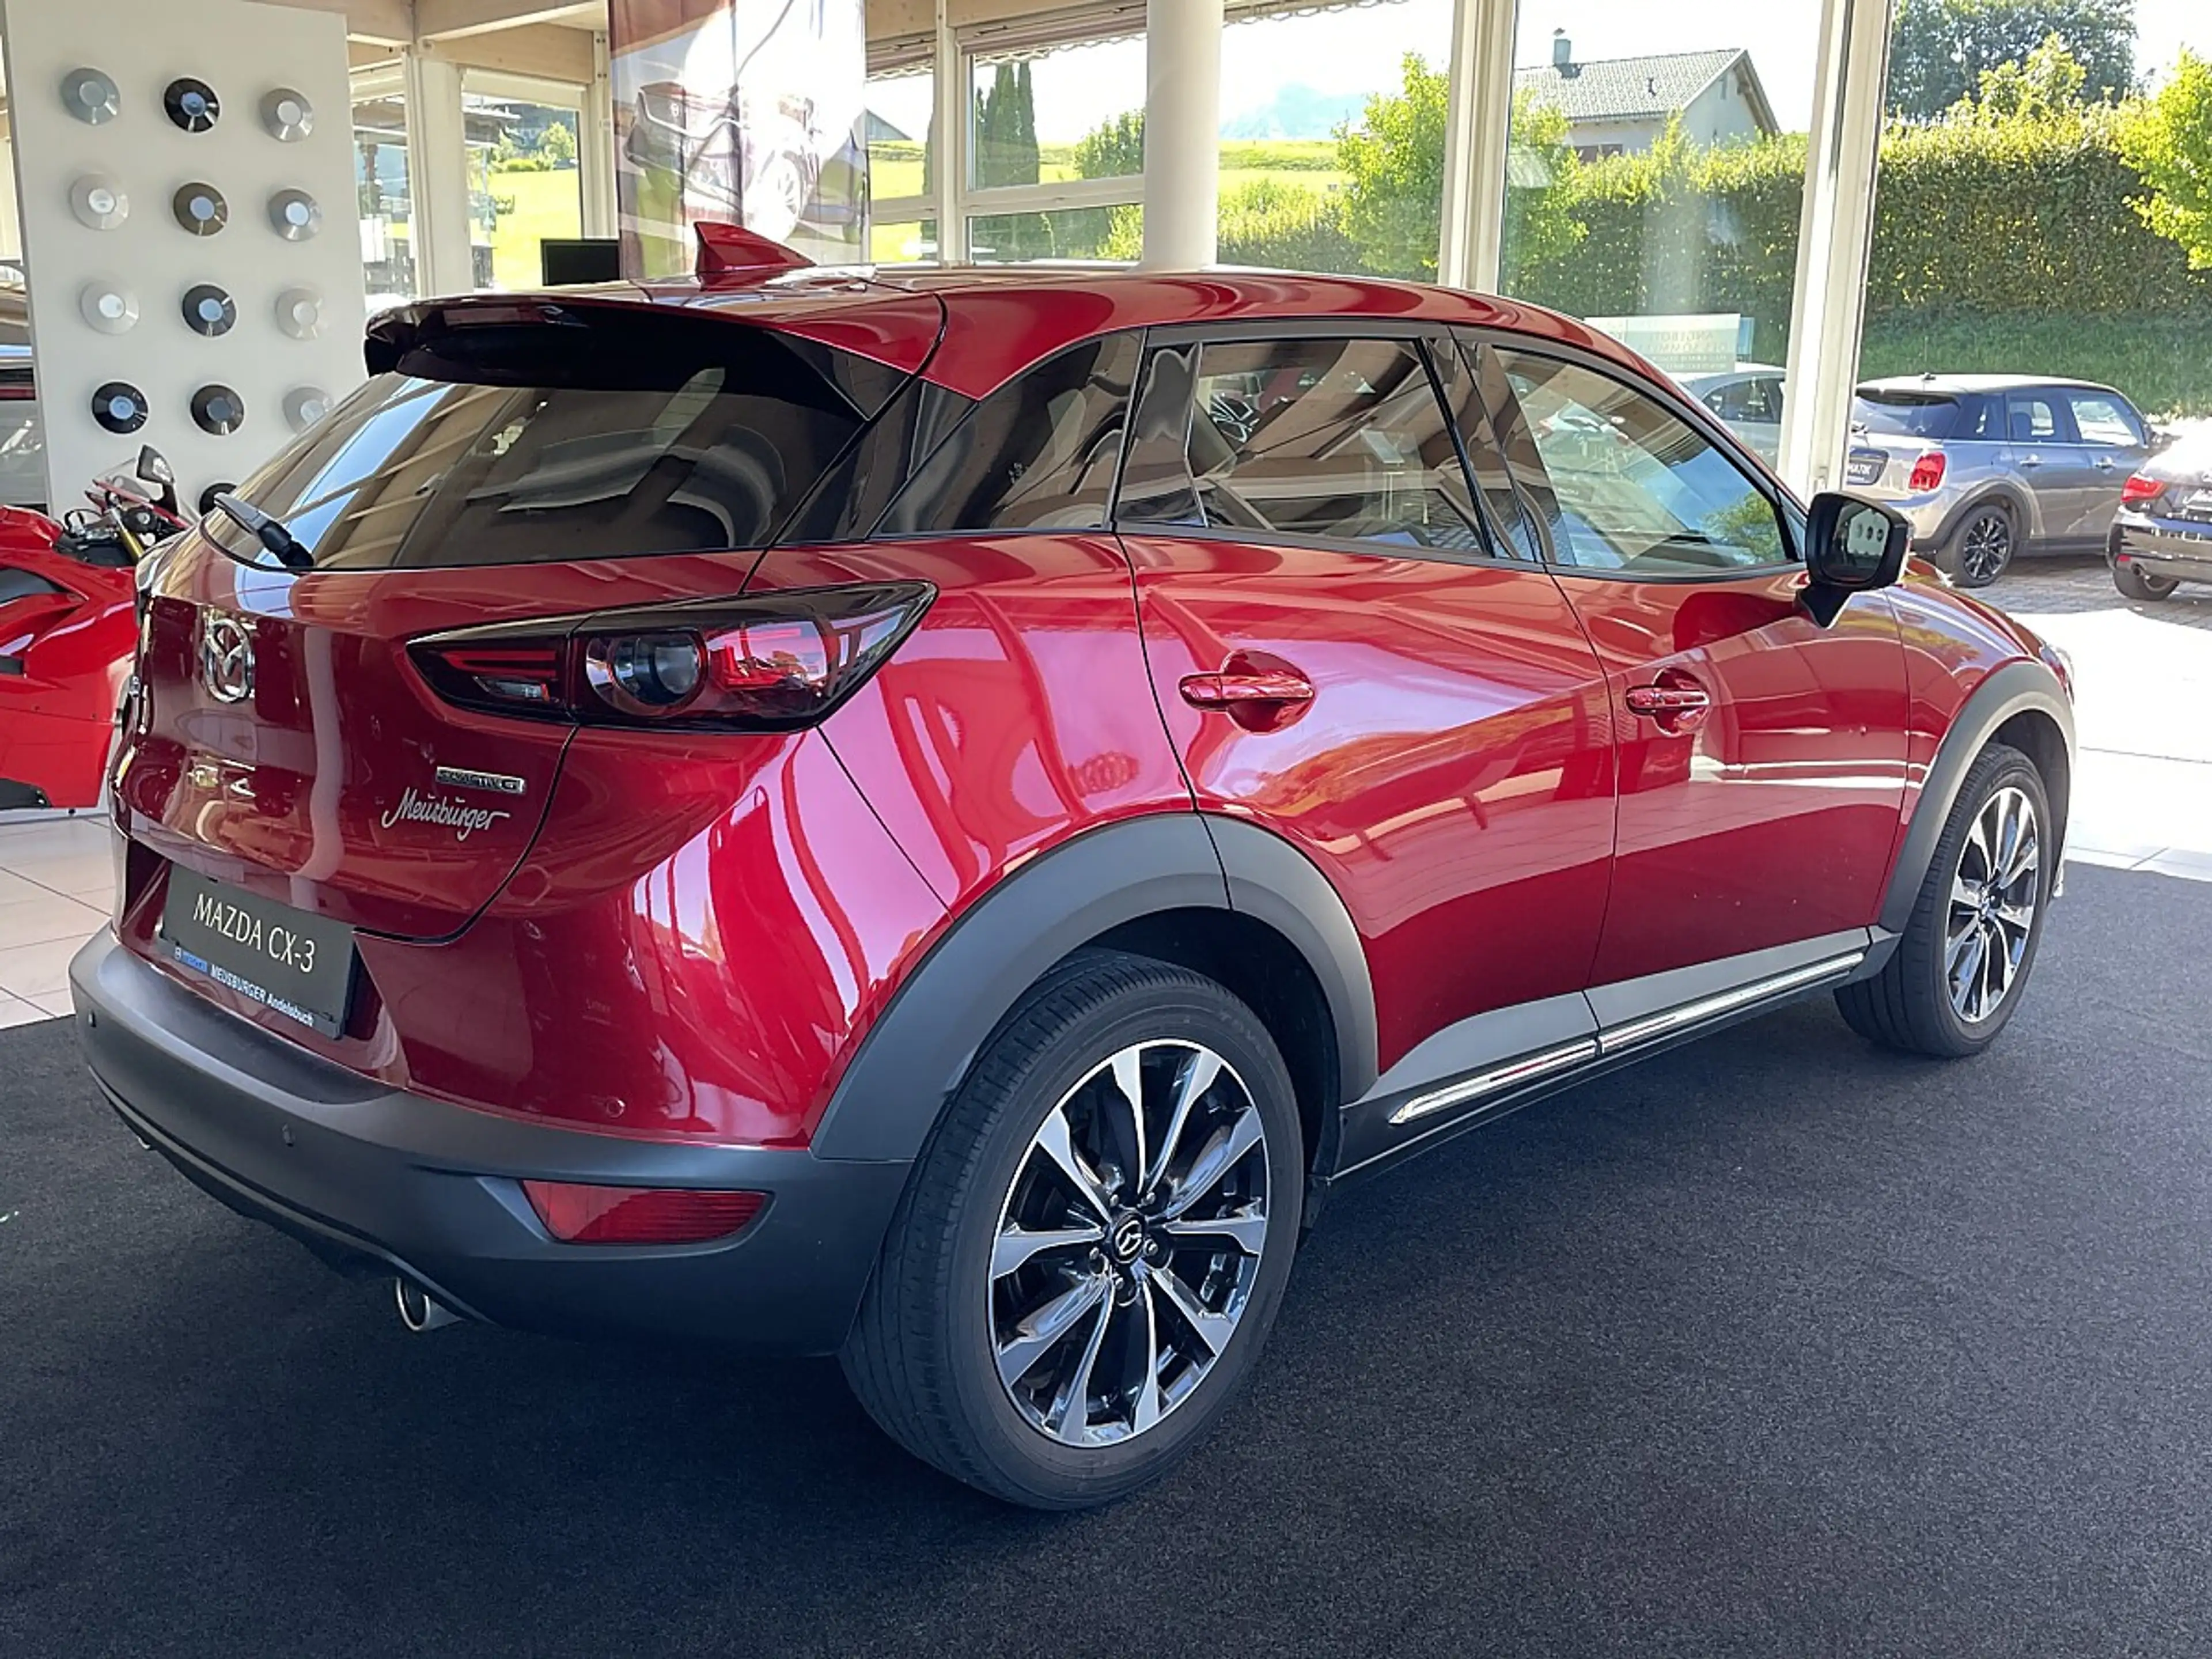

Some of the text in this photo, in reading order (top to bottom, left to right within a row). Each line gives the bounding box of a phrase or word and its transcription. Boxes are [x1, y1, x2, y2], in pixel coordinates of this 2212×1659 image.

[193, 893, 262, 950] MAZDA
[268, 927, 315, 972] CX-3
[210, 964, 267, 1003] MEUSBURGER
